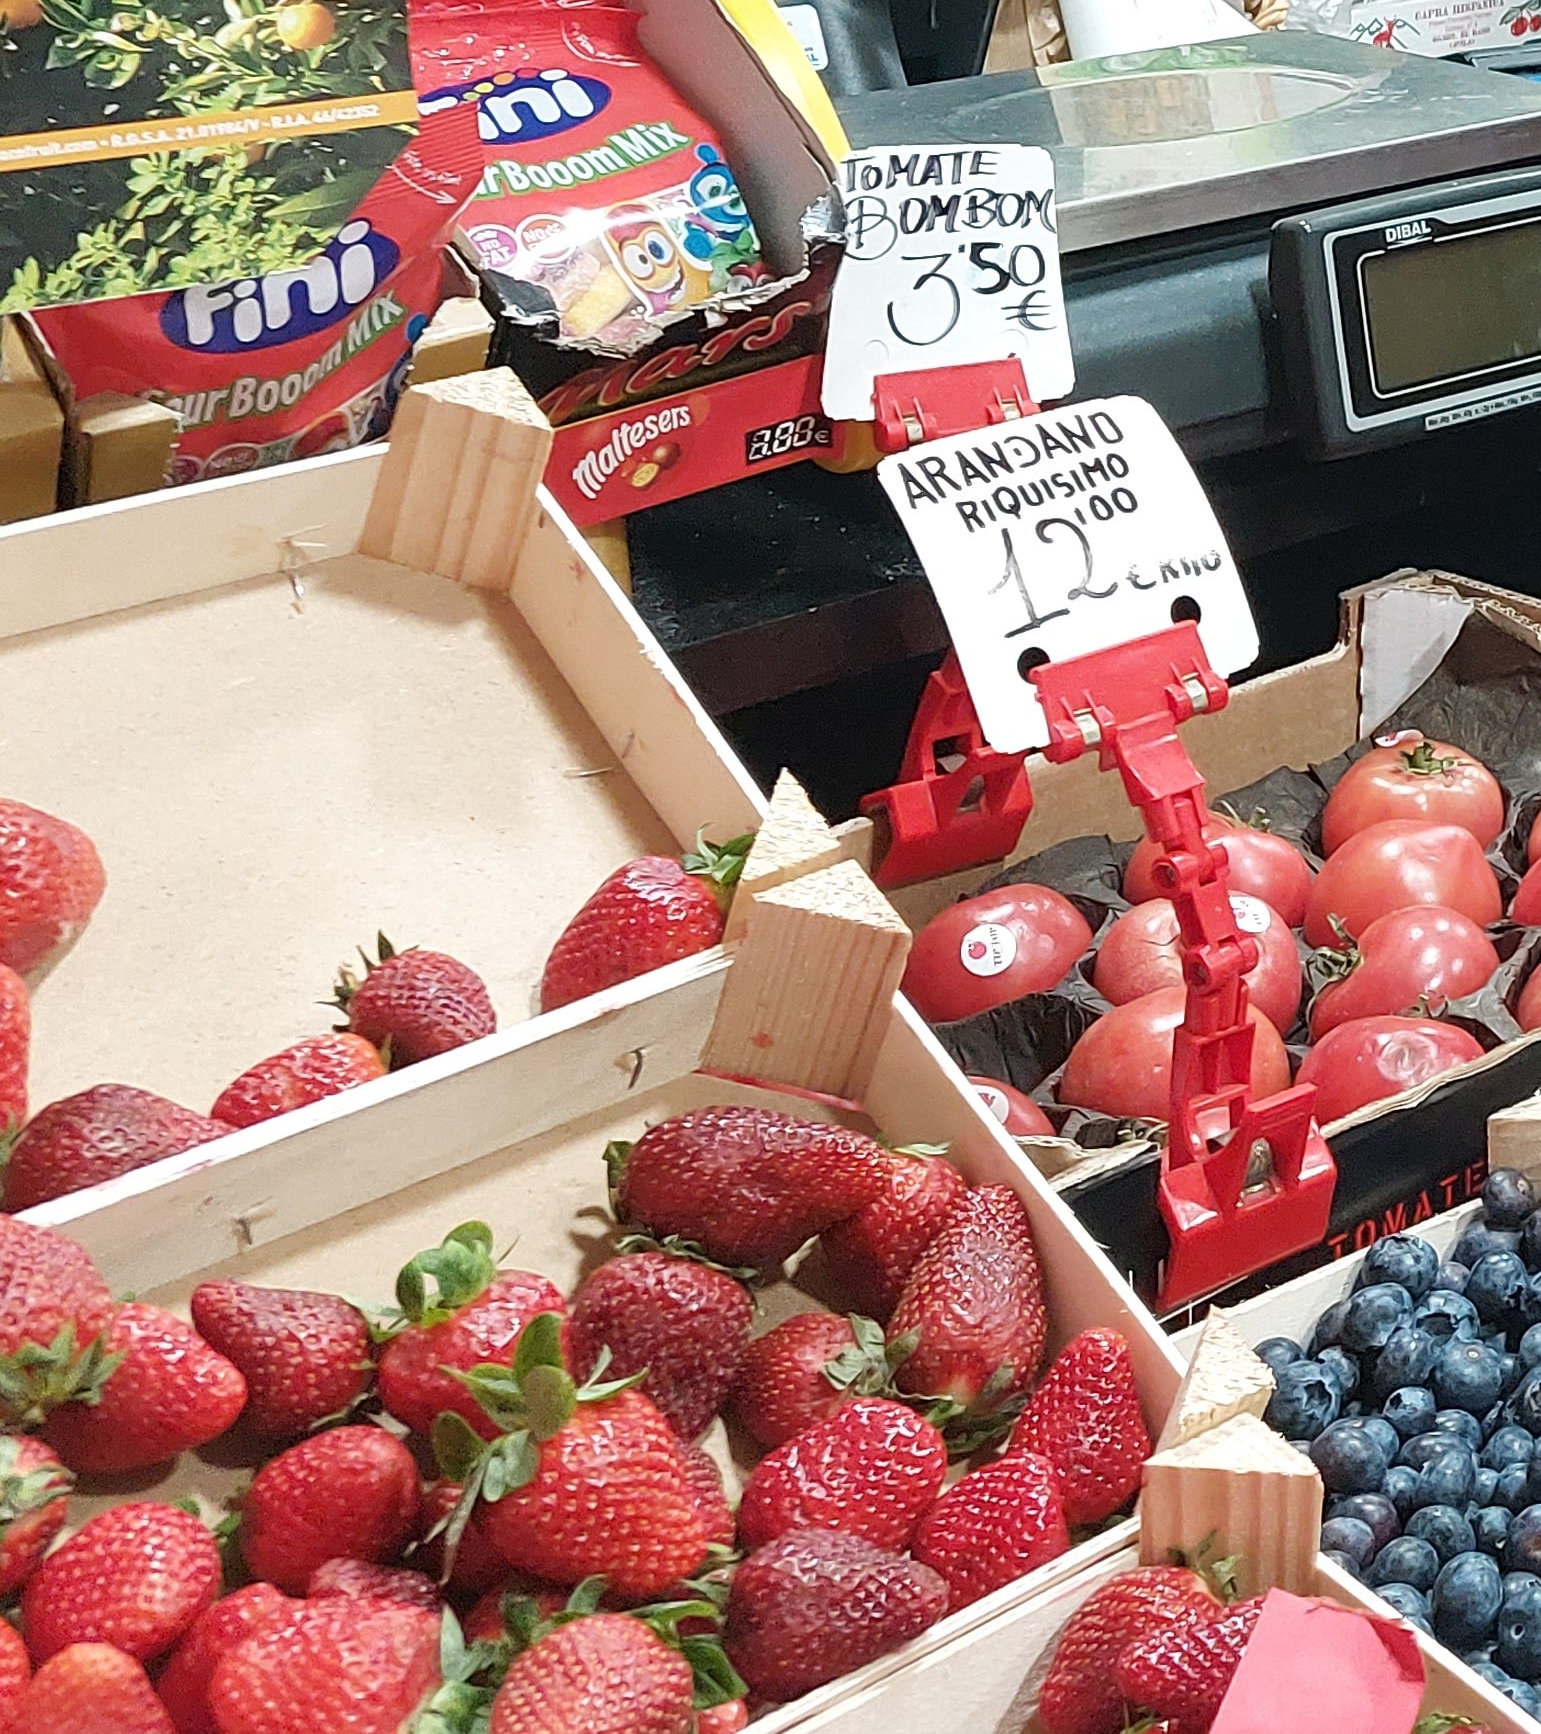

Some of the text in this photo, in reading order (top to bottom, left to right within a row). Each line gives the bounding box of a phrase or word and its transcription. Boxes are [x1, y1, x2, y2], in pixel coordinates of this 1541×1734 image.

[500, 142, 626, 193] Booom
[609, 121, 690, 165] Mix
[841, 151, 1001, 194] TOMATE
[1385, 220, 1432, 244] DIBAL
[1001, 289, 1058, 332] €
[229, 341, 343, 419] Booom
[571, 404, 692, 500] Maltesers
[897, 411, 1126, 510] ARANDANO
[957, 453, 1130, 534] RIQUISIMO
